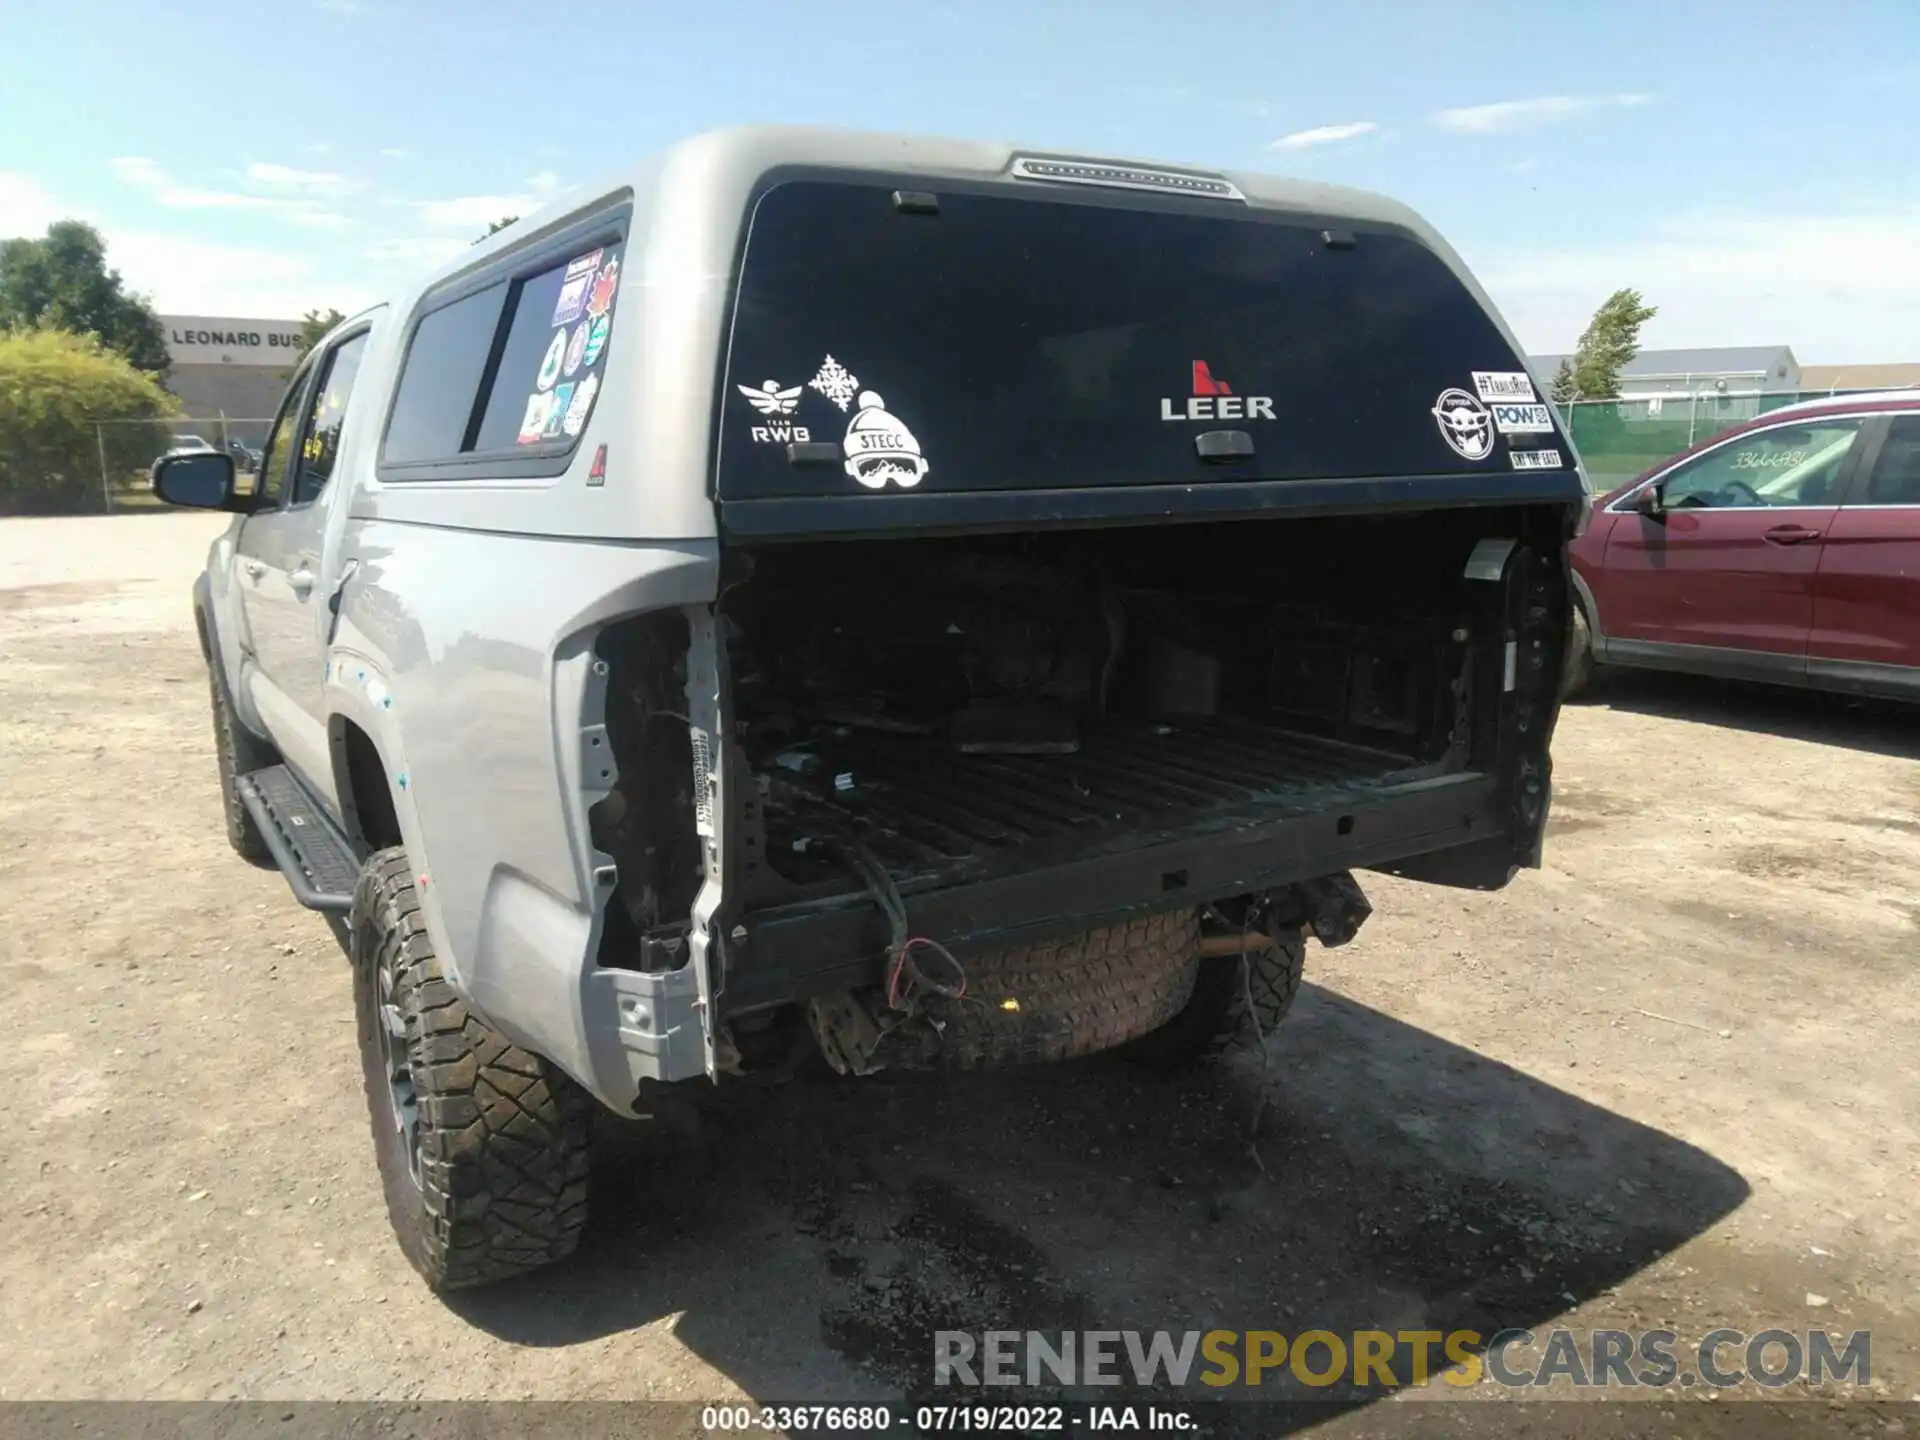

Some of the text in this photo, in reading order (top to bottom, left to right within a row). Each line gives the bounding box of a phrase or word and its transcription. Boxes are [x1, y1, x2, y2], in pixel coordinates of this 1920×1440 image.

[172, 329, 302, 348] LEONARD BUS
[1160, 396, 1278, 421] LEER
[1495, 407, 1534, 424] POW
[752, 427, 809, 443] RWB
